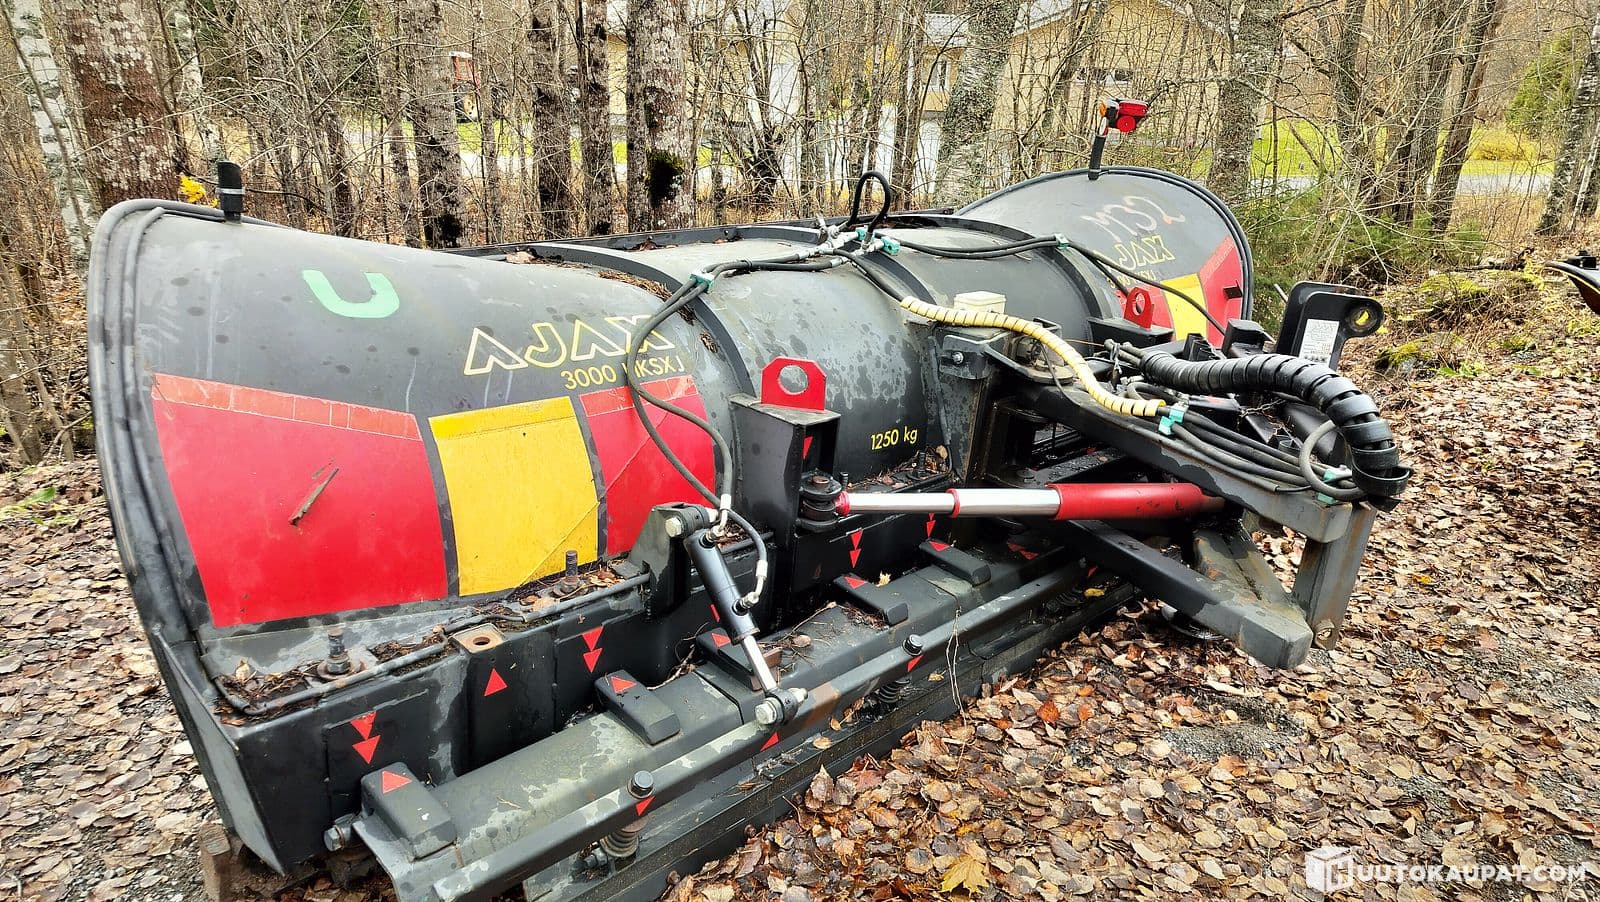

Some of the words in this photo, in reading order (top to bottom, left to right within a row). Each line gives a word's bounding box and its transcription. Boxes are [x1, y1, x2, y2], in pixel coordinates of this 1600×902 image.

[463, 314, 676, 376] AJAX
[560, 364, 618, 390] 3000
[870, 428, 899, 451] 1250
[903, 425, 918, 445] kg
